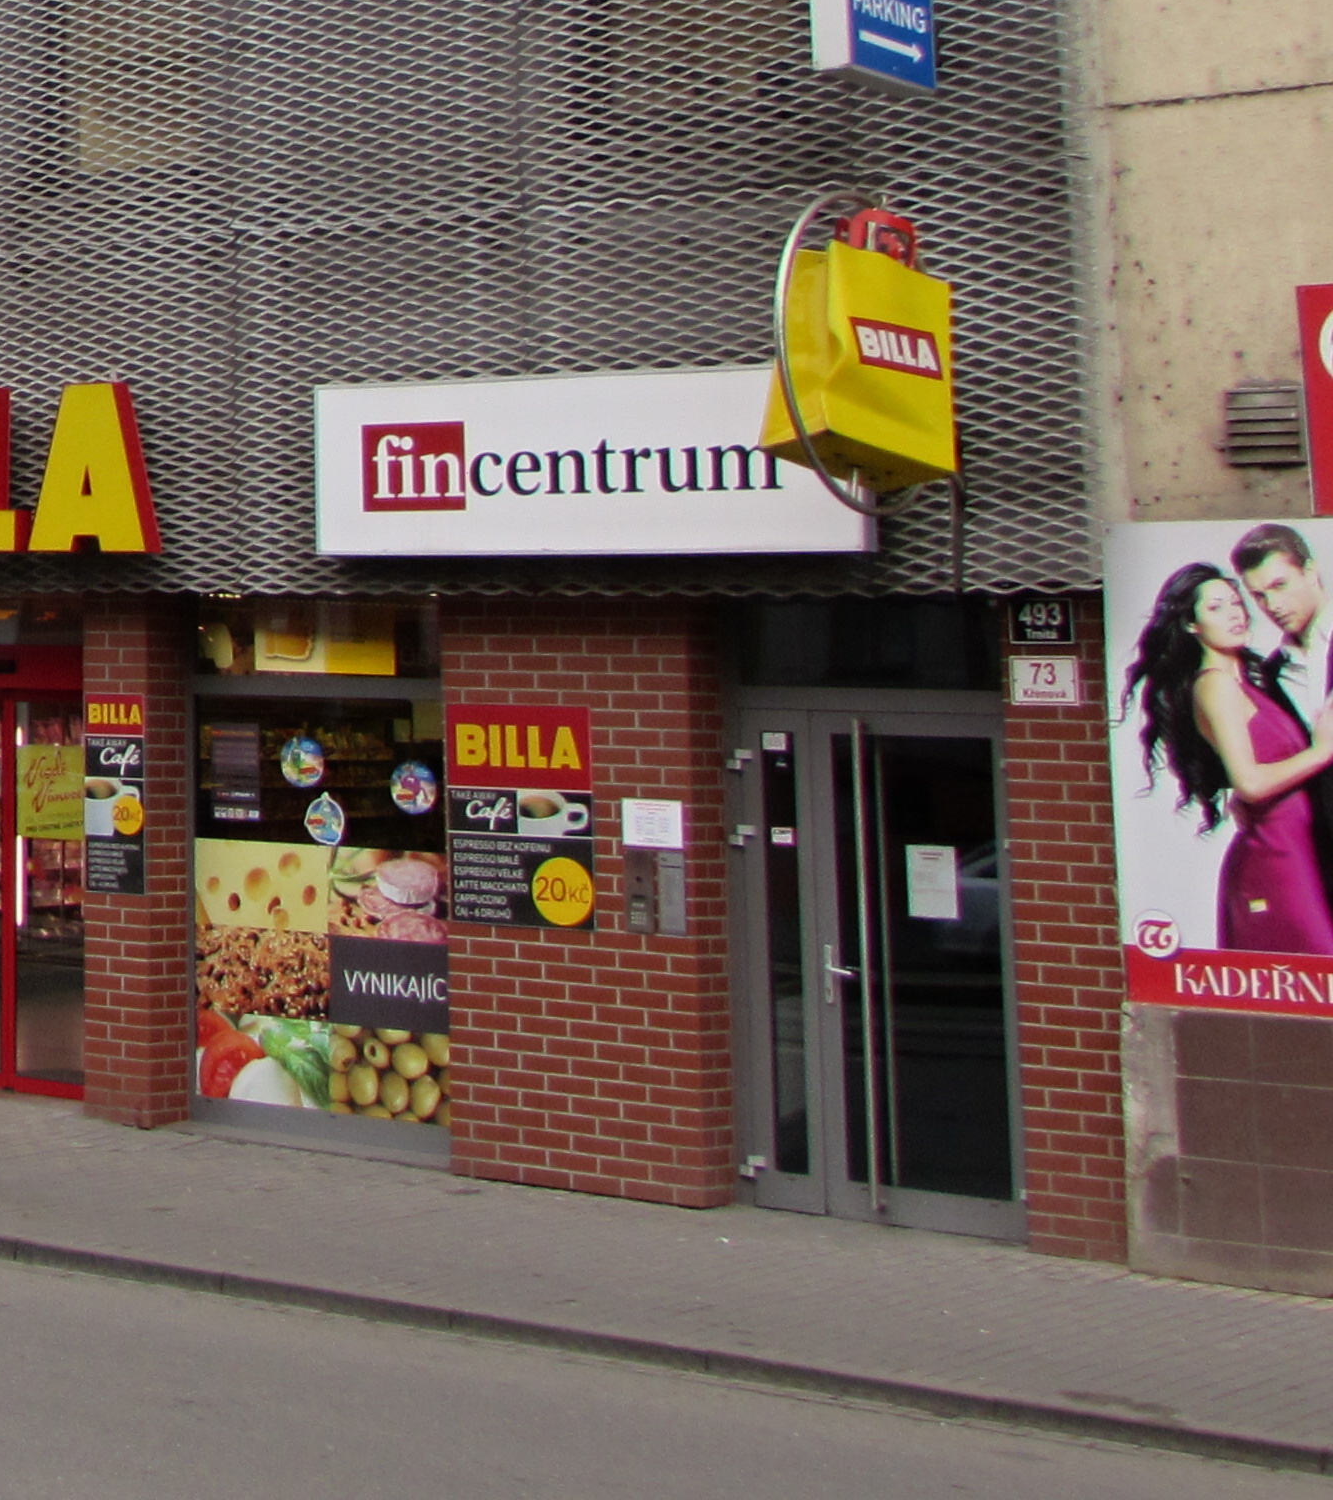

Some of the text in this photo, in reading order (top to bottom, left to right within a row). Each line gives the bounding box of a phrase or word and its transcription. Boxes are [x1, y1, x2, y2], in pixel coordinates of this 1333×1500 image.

[854, 324, 939, 372] BILLA
[372, 434, 784, 499] fincentrum
[1018, 602, 1062, 626] 493
[1024, 628, 1058, 639] Trnitá
[1029, 663, 1057, 686] 73
[88, 703, 142, 726] BILLA
[455, 723, 582, 770] BILLA
[99, 743, 141, 776] Café
[451, 790, 472, 799] TAKE
[113, 805, 130, 821] 20
[465, 797, 513, 831] Café
[452, 838, 496, 850] ESPRESSO
[453, 852, 496, 864] ESPRESSO
[453, 866, 497, 878] ESPRESSO
[454, 879, 529, 894] LATTE MACCHIATO
[535, 876, 567, 903] 20
[454, 893, 507, 905] CAPPUCCINO
